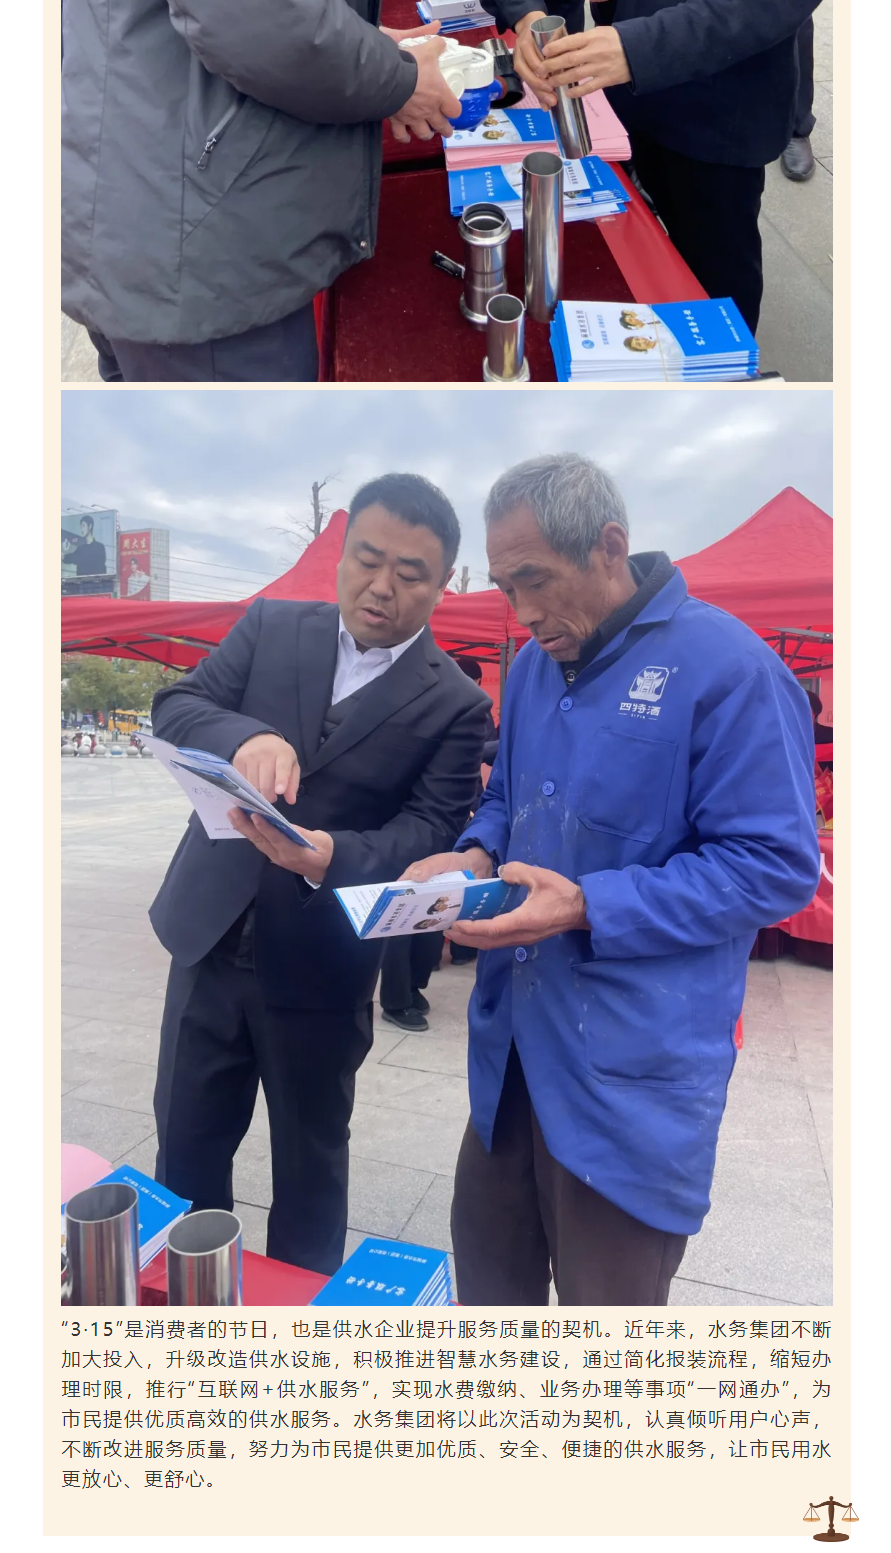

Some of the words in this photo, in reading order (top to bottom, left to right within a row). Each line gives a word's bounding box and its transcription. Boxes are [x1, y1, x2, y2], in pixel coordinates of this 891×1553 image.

[123, 537, 147, 549] 周大生
[619, 702, 661, 717] 四特酒
[345, 1275, 407, 1297] 客户服务手册
